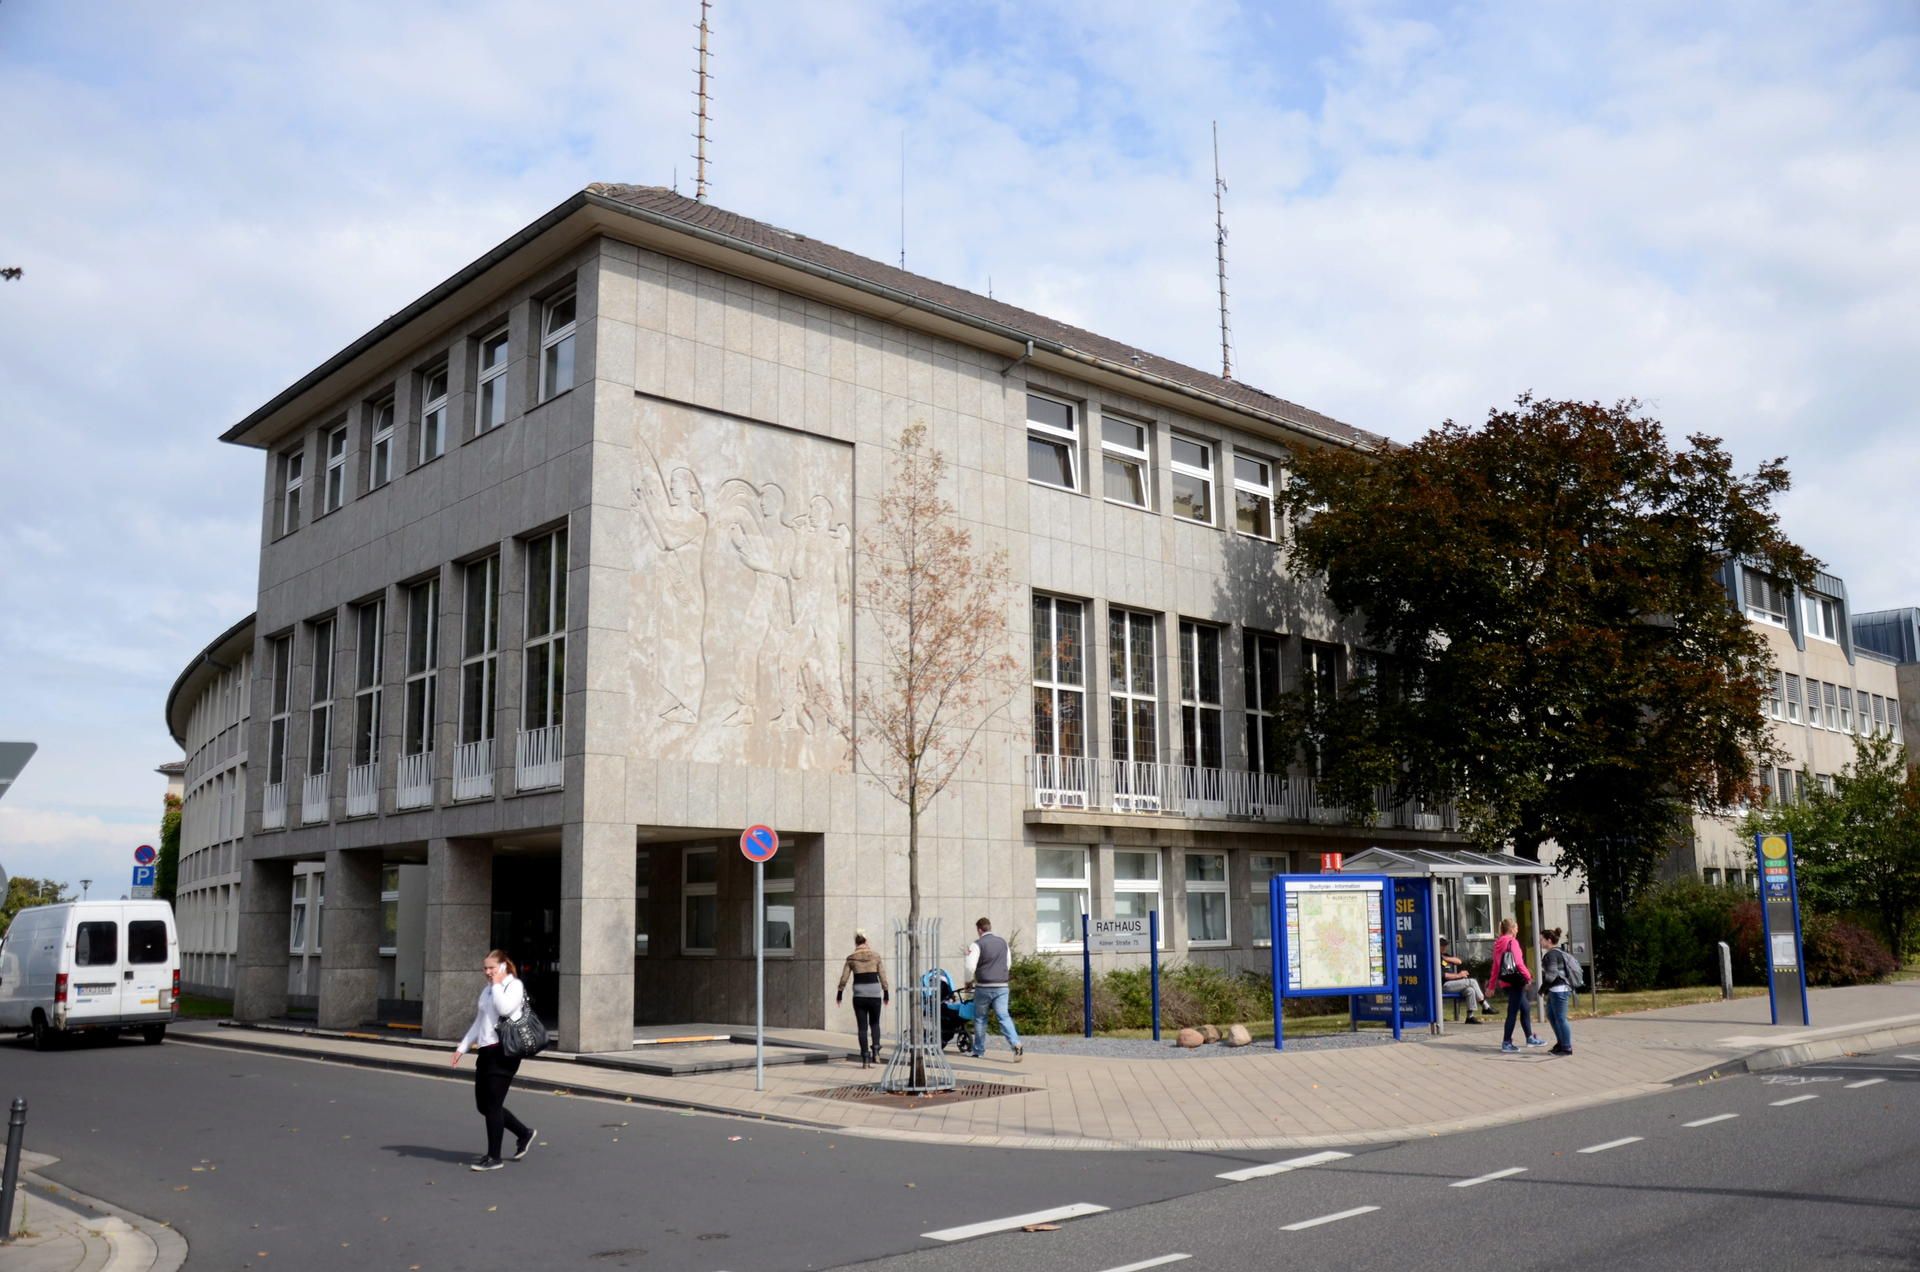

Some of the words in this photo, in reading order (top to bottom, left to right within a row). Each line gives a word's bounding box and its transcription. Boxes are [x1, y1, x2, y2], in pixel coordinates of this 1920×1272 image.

[137, 868, 150, 884] P
[1396, 898, 1415, 913] SIE
[1096, 920, 1142, 932] RATHAUS
